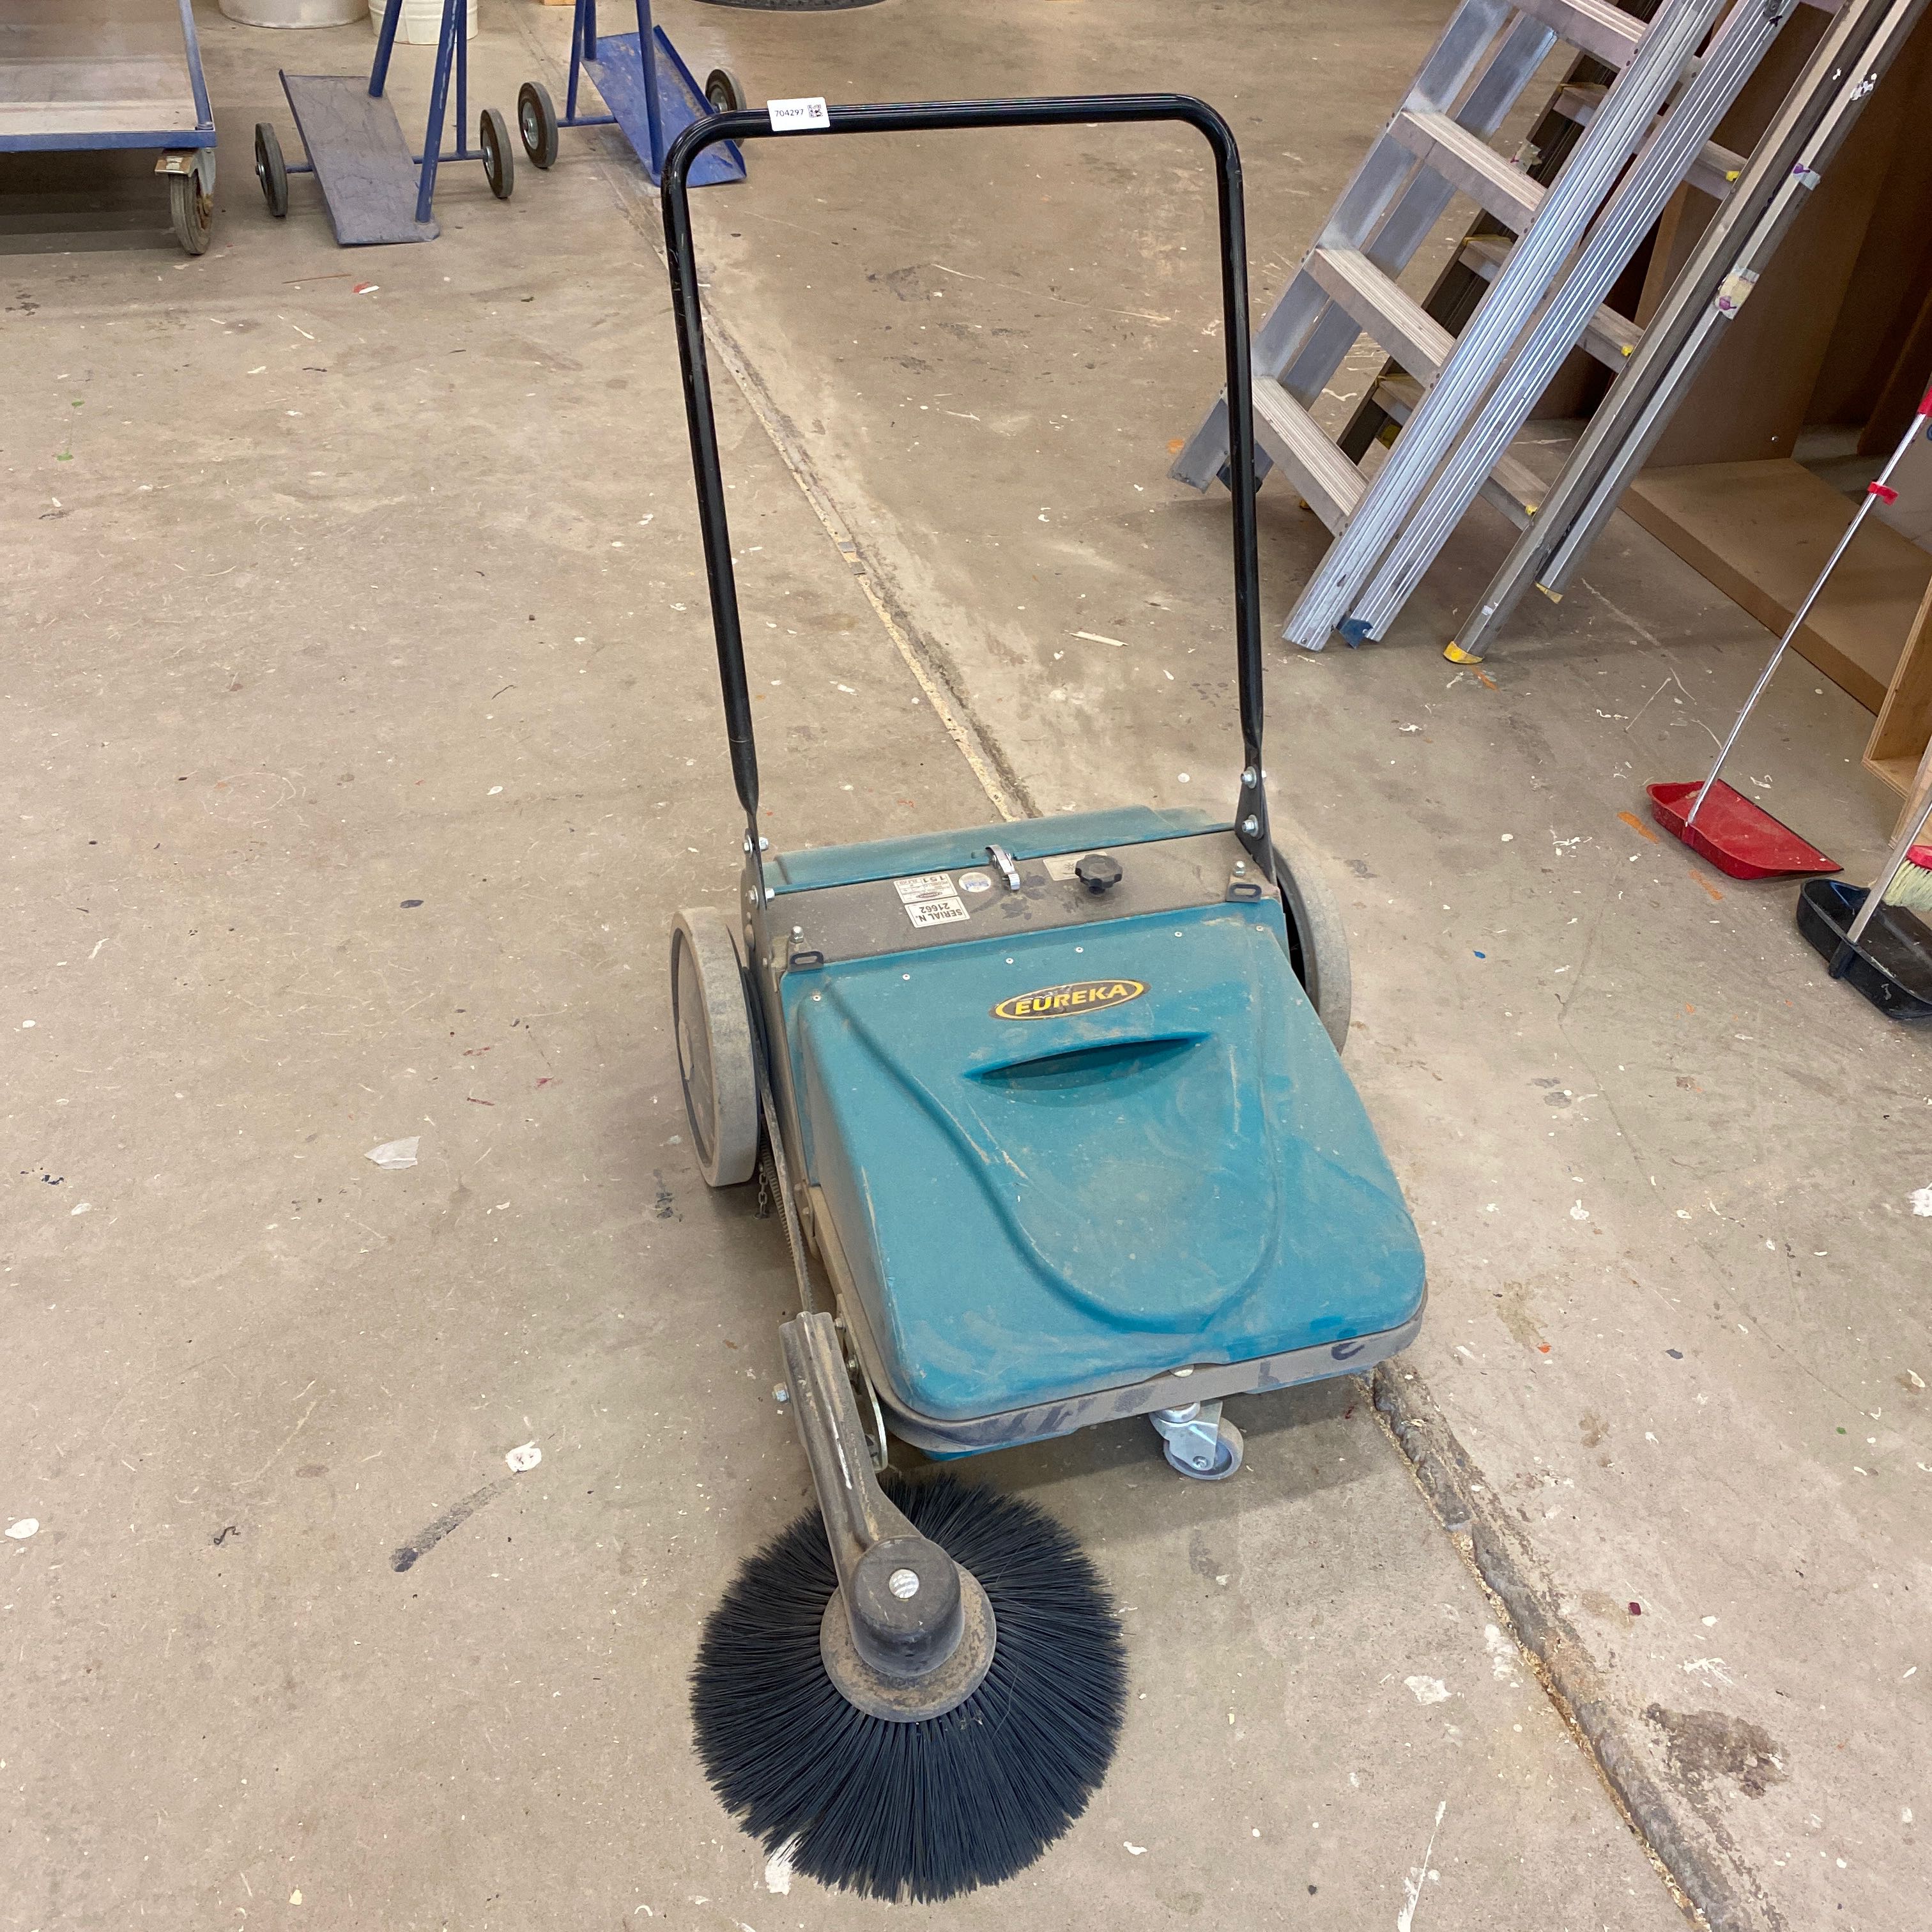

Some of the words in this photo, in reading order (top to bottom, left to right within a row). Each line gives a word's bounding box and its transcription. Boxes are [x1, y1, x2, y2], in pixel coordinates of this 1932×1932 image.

[774, 109, 804, 117] 704297
[923, 875, 945, 883] 151
[919, 903, 950, 914] 21662
[928, 908, 963, 920] SERIAL
[1015, 984, 1128, 1015] EUREKA
